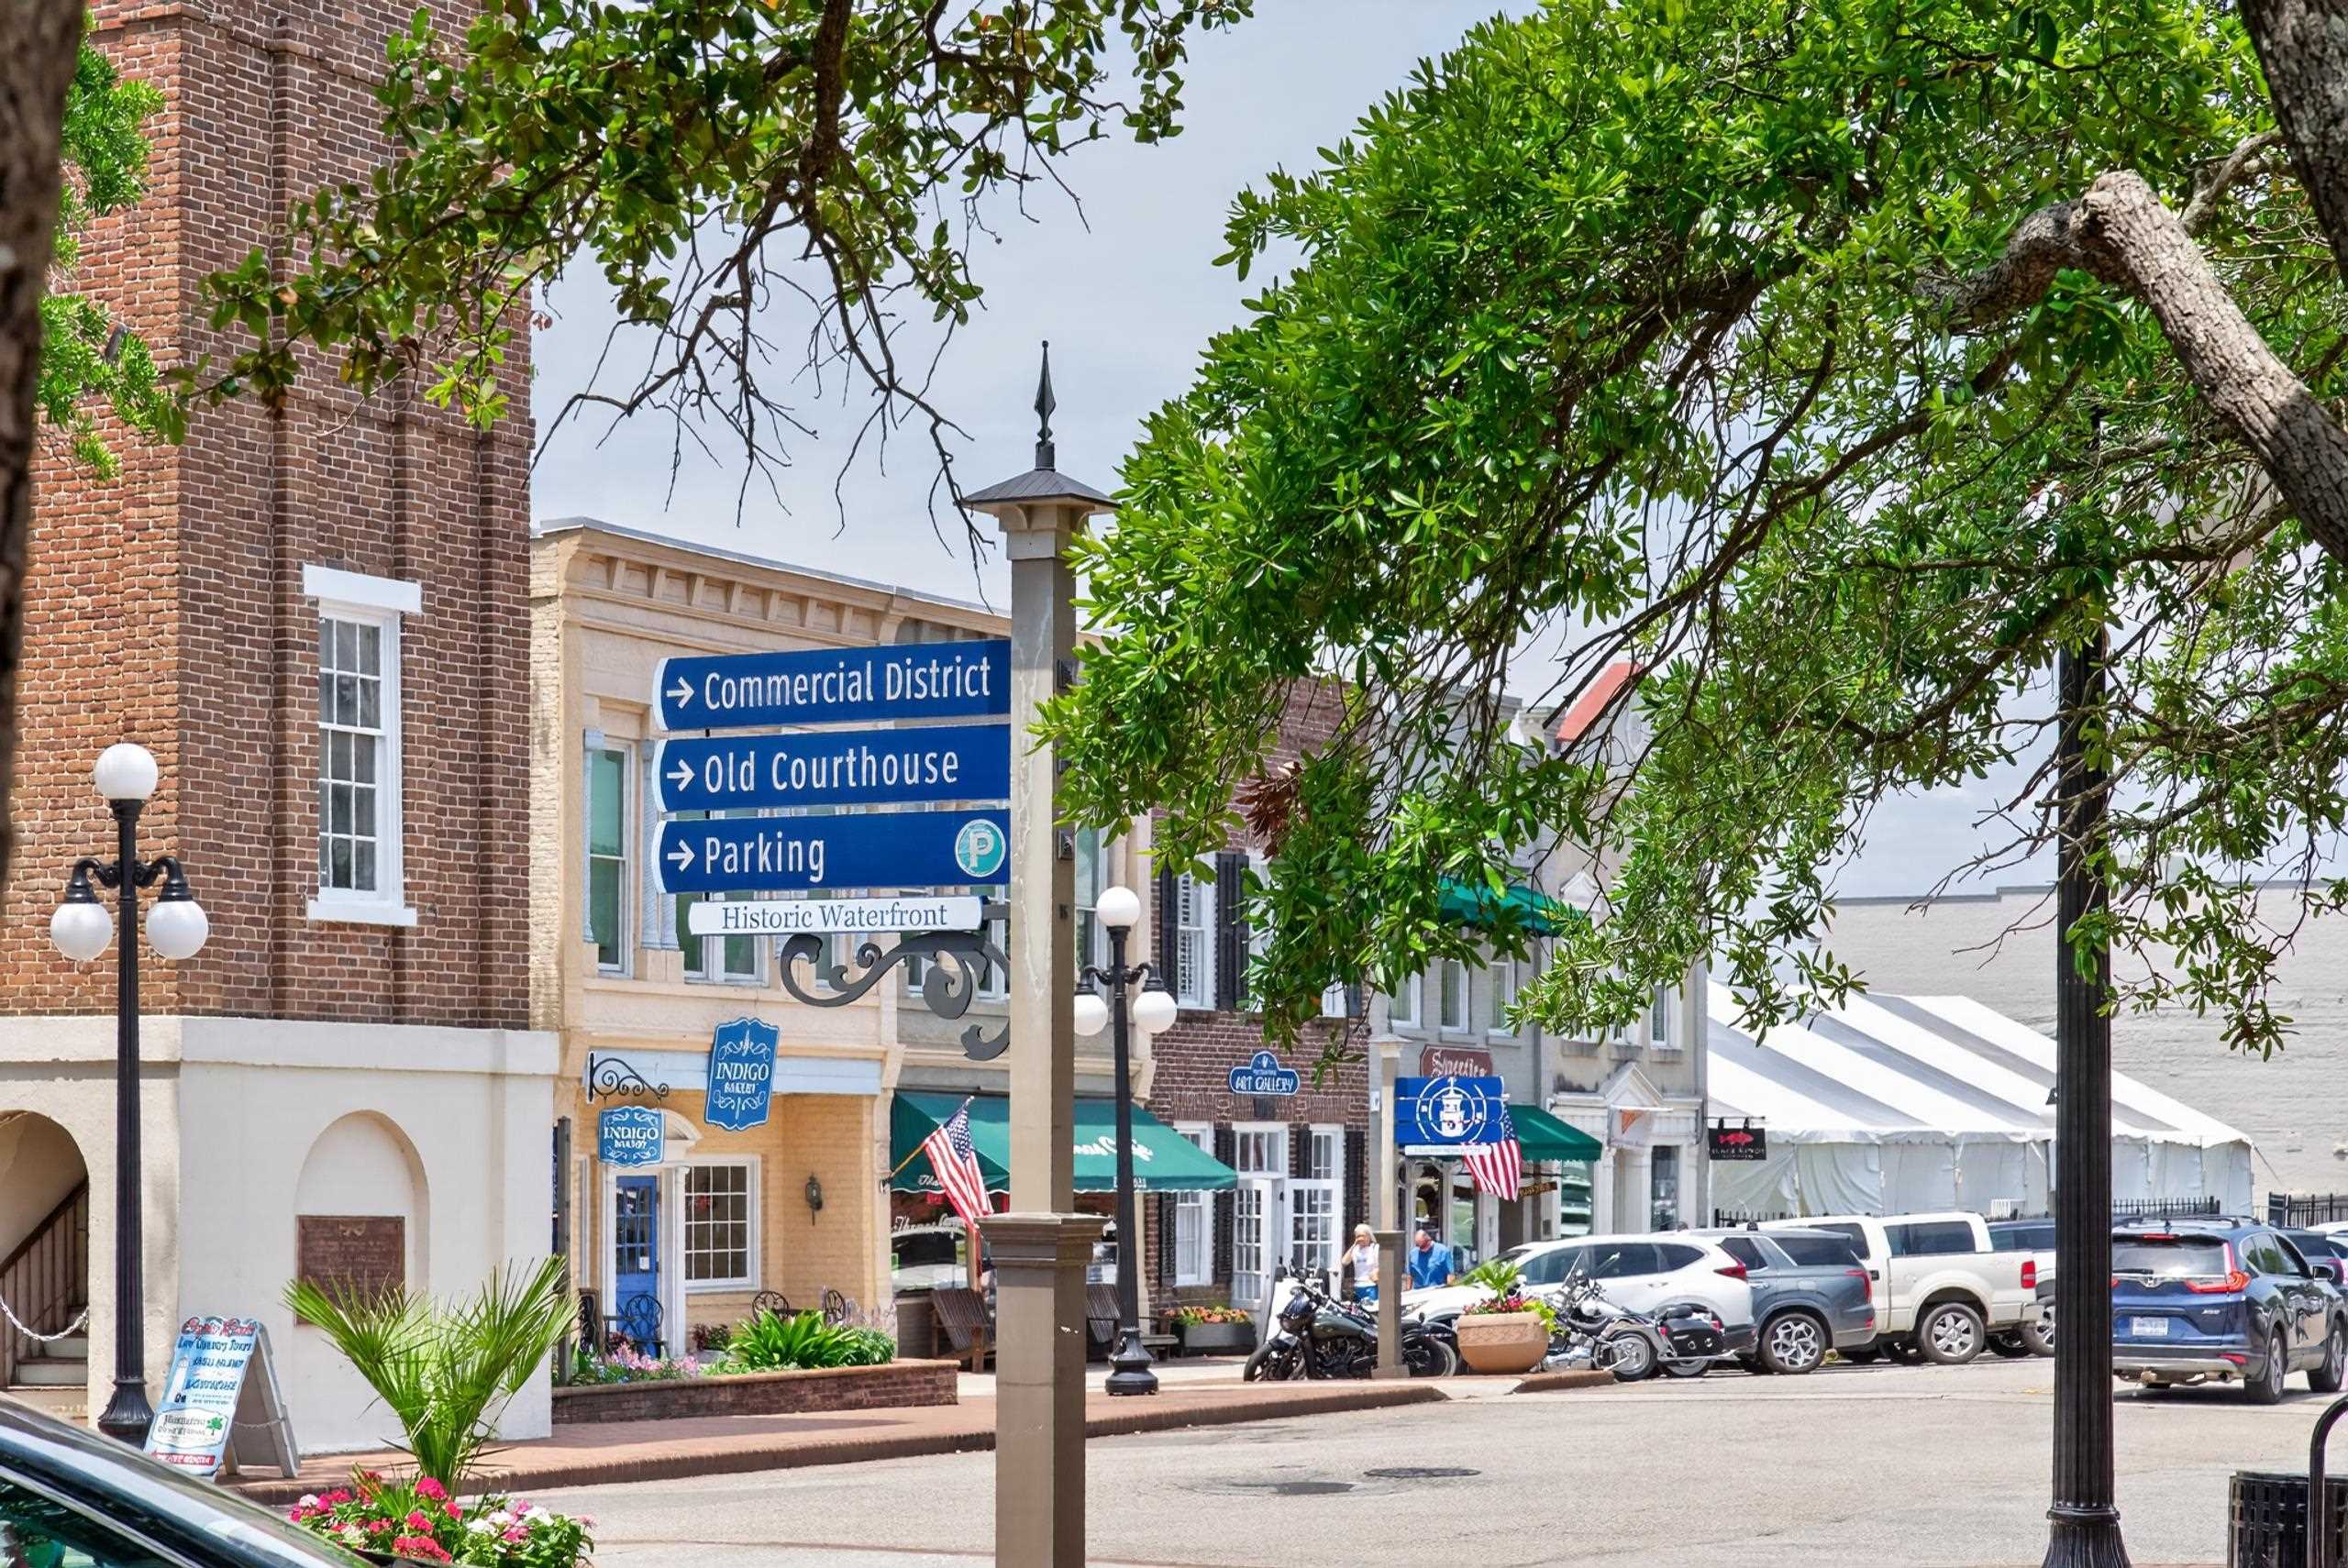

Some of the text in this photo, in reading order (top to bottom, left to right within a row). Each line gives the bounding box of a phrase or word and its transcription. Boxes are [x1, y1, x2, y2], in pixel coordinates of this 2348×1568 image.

[704, 656, 991, 710] Commercial District
[704, 745, 958, 793] Old Courthouse
[705, 830, 993, 883] Parking P
[722, 901, 947, 930] Historic Waterfront
[715, 1062, 770, 1081] INDIGO
[1235, 1075, 1294, 1092] ART GALLERY
[604, 1126, 659, 1141] INDIGO
